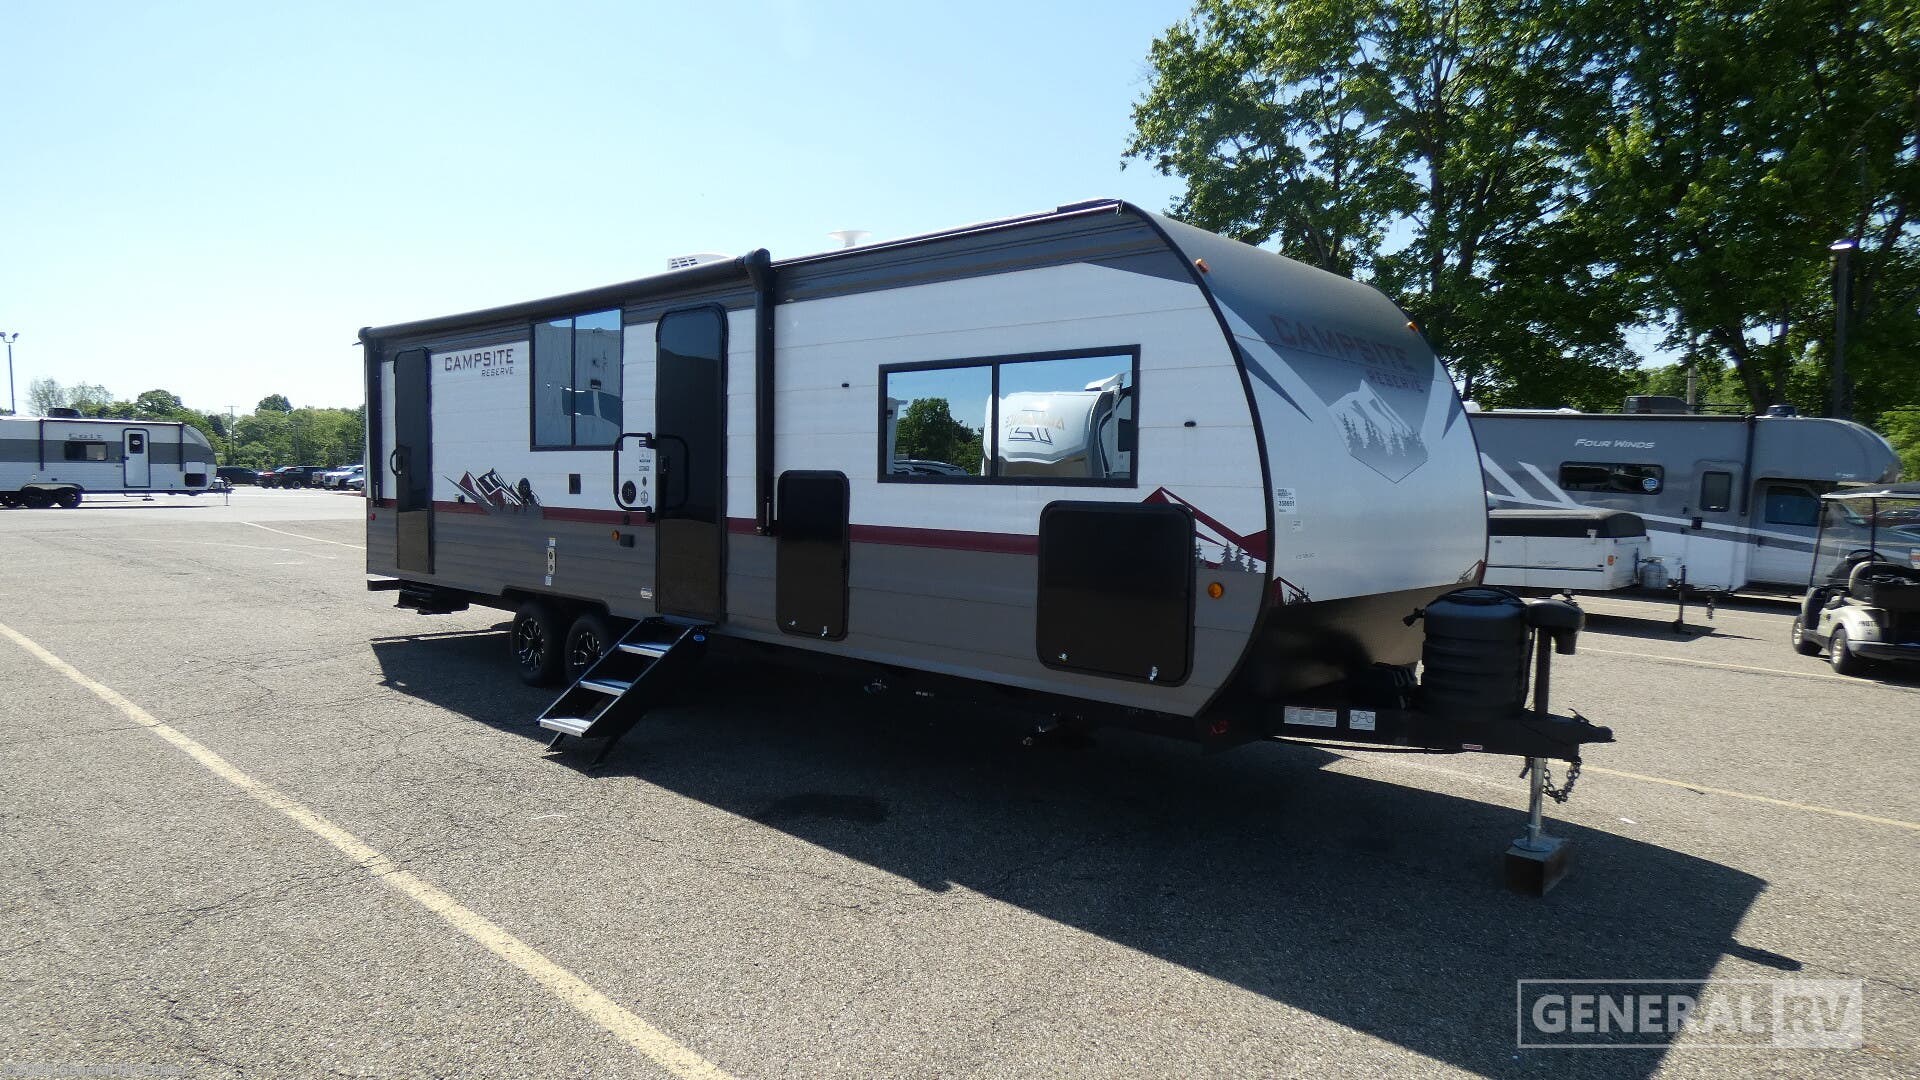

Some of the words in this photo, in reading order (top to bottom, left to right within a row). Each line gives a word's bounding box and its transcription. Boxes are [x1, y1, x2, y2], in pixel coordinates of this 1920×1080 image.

[1270, 313, 1420, 374] CAMPSITE
[444, 348, 514, 371] CAMPSITE
[481, 366, 514, 377] RESERVE
[1366, 367, 1425, 394] RESERVE
